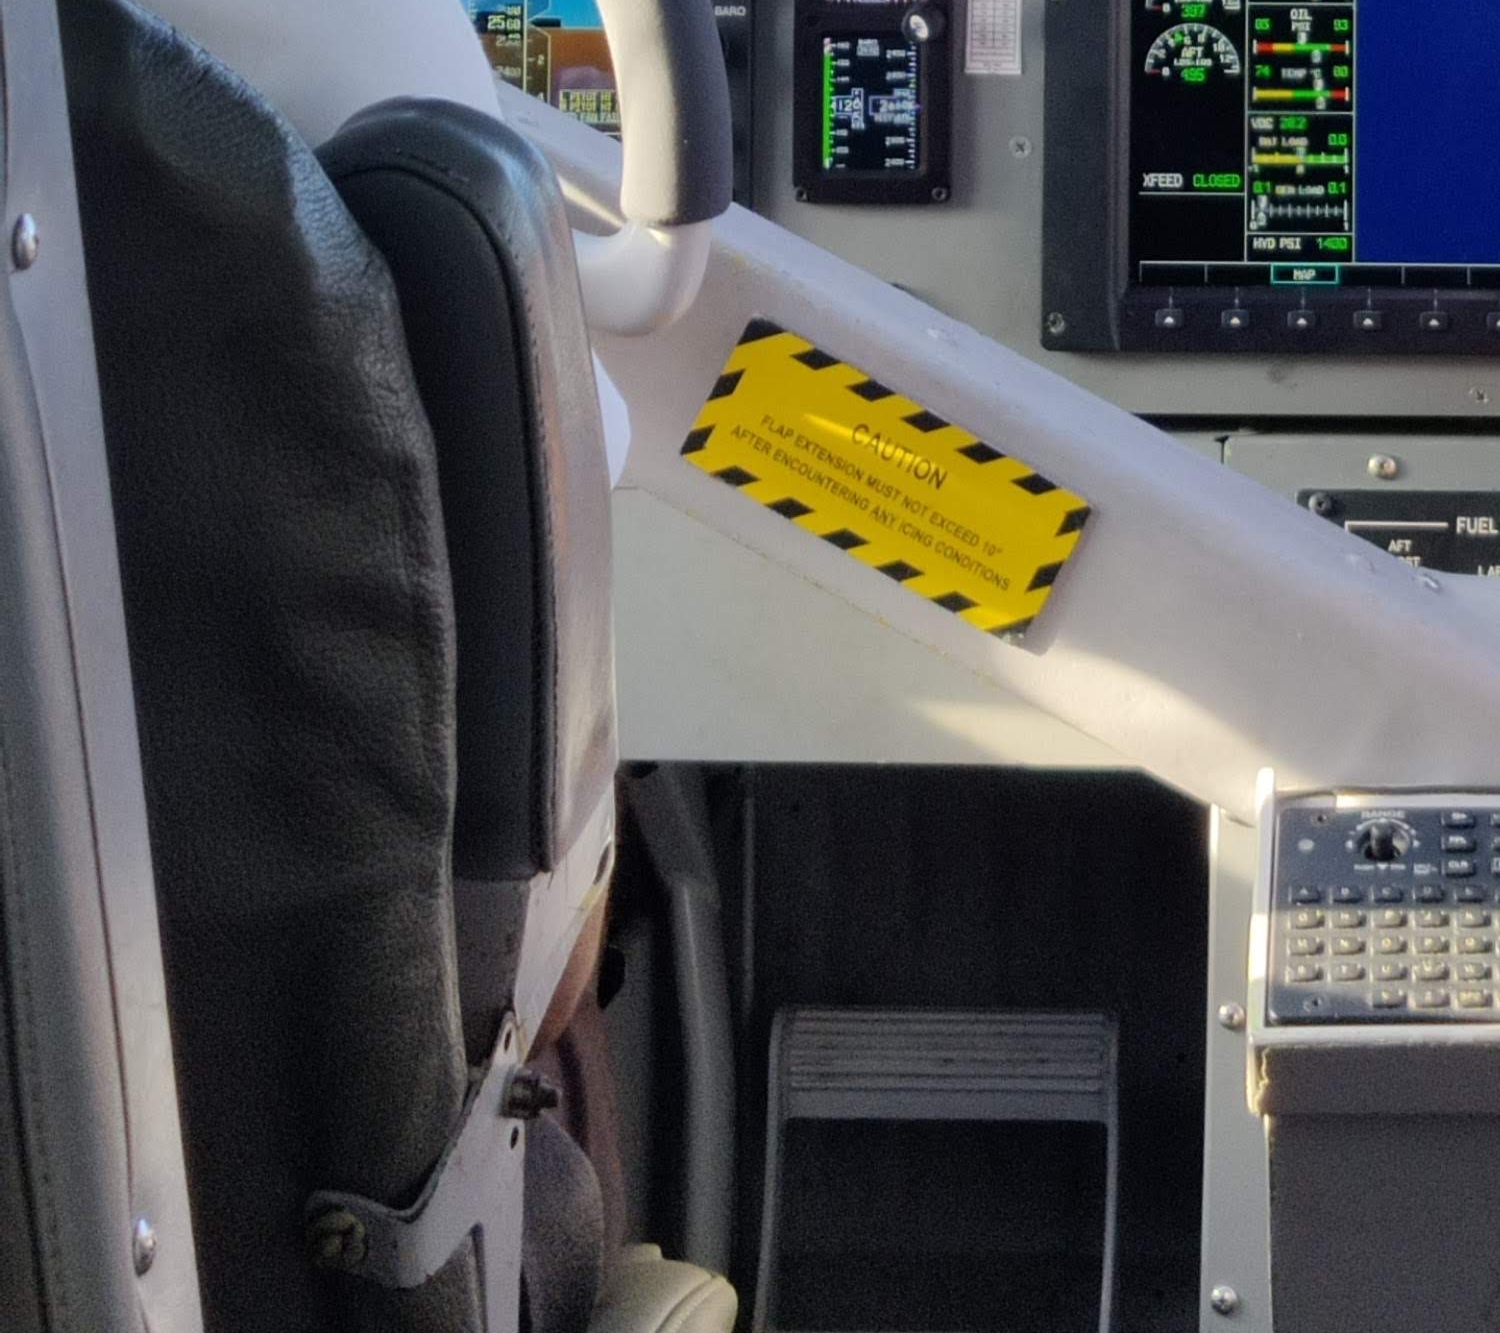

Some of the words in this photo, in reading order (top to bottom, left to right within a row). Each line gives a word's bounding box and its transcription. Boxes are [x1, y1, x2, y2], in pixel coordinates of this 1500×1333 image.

[1290, 8, 1312, 21] OIL
[1142, 172, 1184, 187] XFEED
[1192, 174, 1241, 188] CLOSED
[1279, 236, 1302, 250] PSI
[1292, 268, 1317, 281] MAP
[850, 422, 948, 491] CAUTION
[760, 414, 794, 441] FLAP
[796, 433, 866, 483] EXTENSION
[866, 474, 902, 503] MUST
[901, 494, 930, 518] NOT
[928, 510, 981, 548] EXCEED
[730, 423, 774, 453] AFTER
[771, 447, 870, 513] ENCOUNTERING
[870, 504, 898, 530] ANY
[898, 521, 934, 548] ICING
[933, 540, 1011, 592] CONDITIONS
[1455, 517, 1499, 535] FUEL
[1387, 538, 1413, 553] AFT
